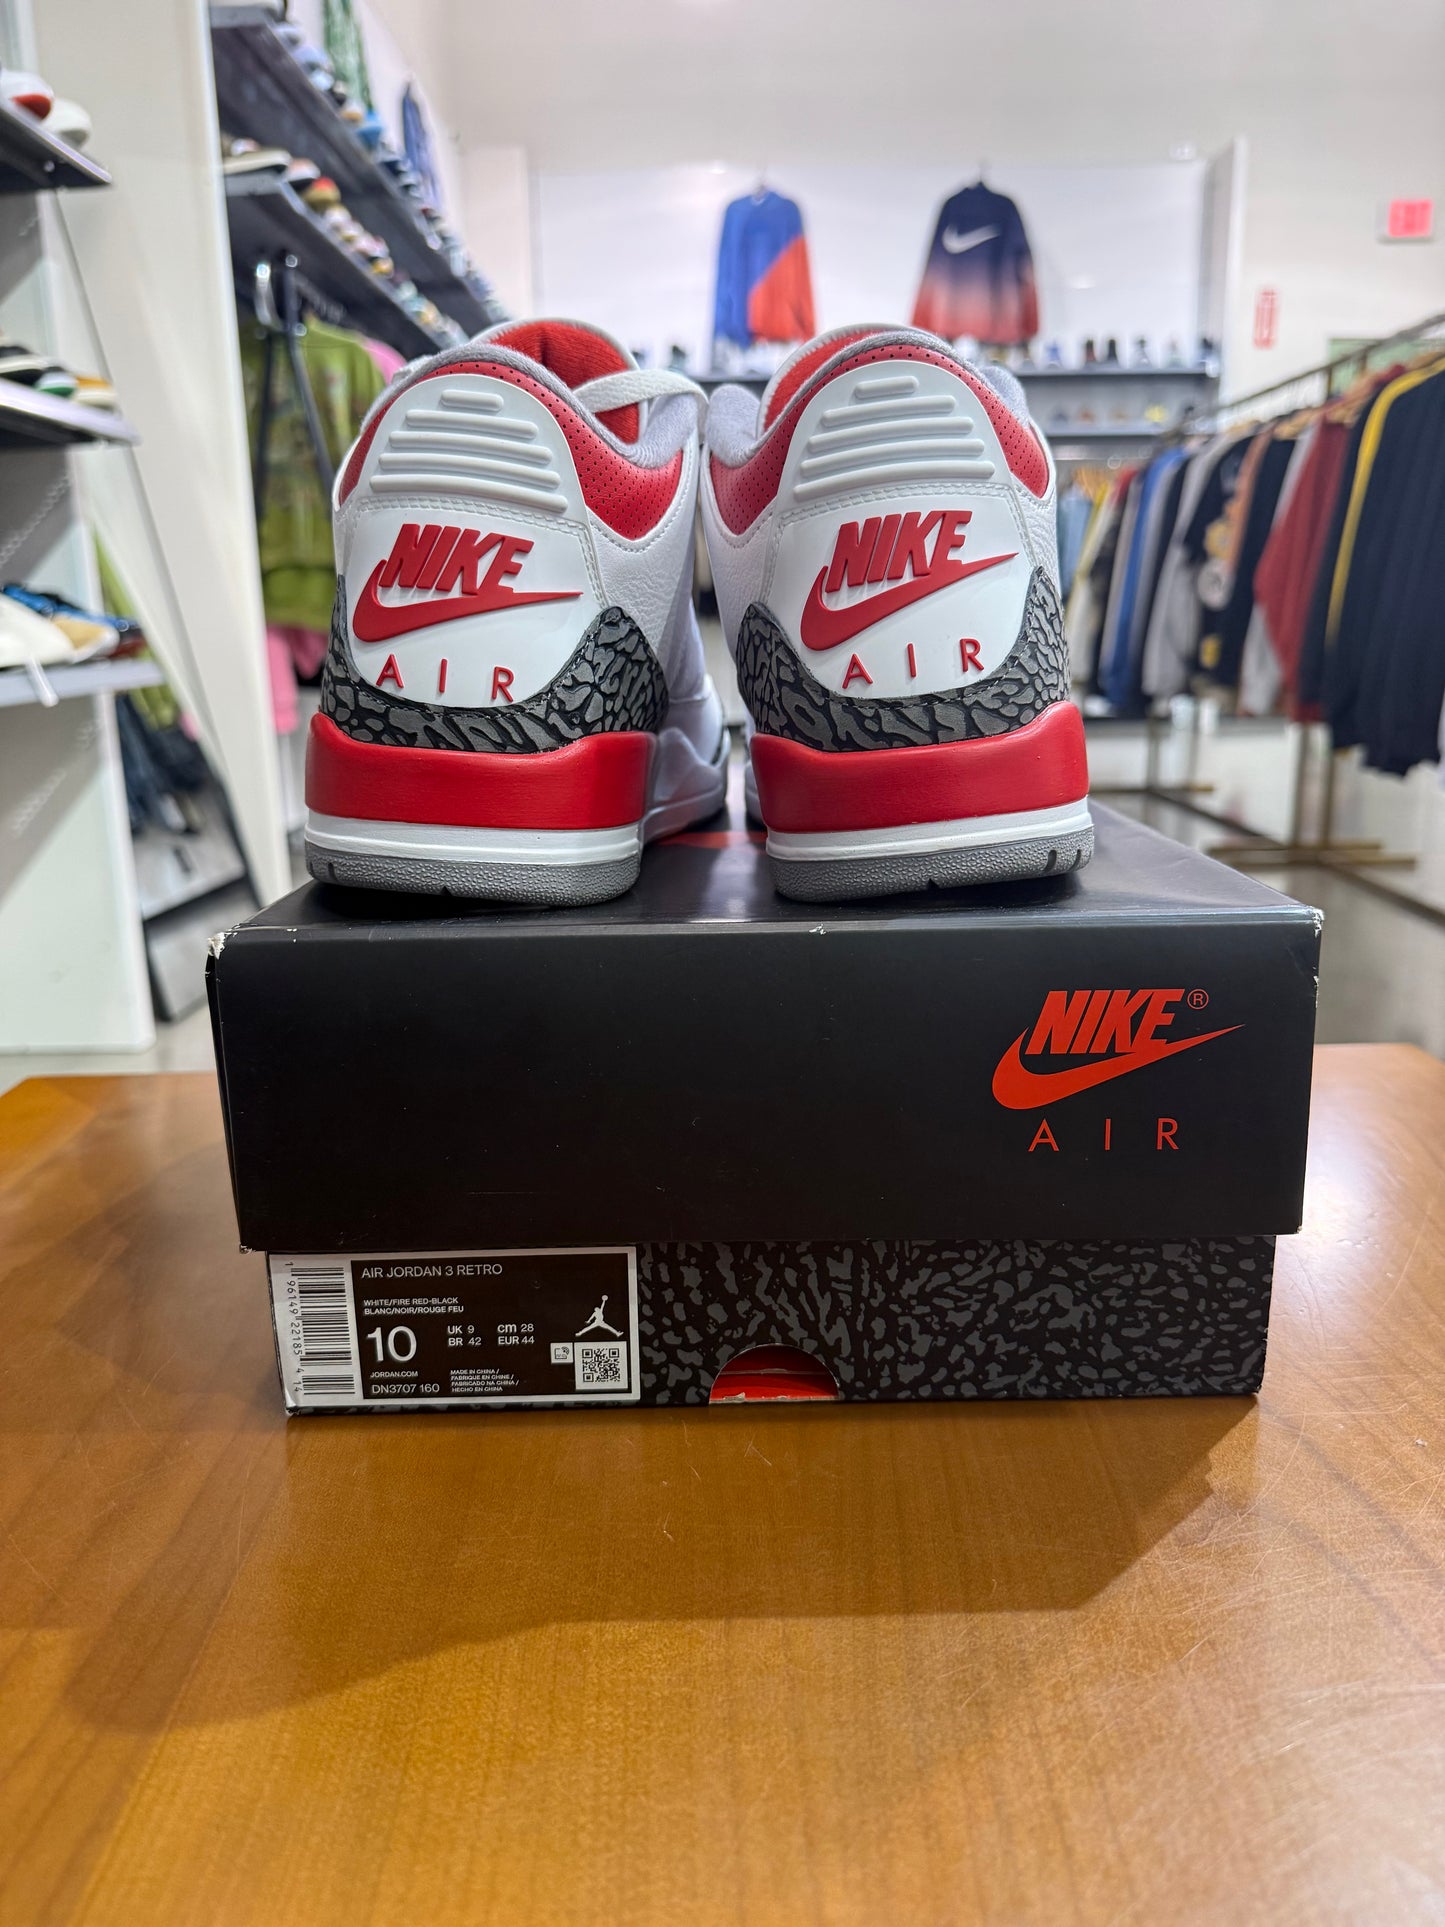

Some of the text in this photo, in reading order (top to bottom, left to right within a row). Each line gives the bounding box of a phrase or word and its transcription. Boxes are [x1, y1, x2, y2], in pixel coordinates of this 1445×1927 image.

[825, 511, 973, 593] NIKE
[378, 523, 535, 596] NIKE
[361, 1263, 503, 1279] AIR JORDAN 3 RETRO
[286, 1280, 299, 1315] 96149
[363, 1296, 459, 1307] WHITE/FIRE RED-BLACK
[364, 1305, 464, 1316] BLANC/NOIR/ROUGE FEU
[447, 1325, 475, 1335] UK 9
[497, 1323, 535, 1334] cm 28
[290, 1322, 303, 1356] 22185
[366, 1325, 418, 1363] 10
[447, 1336, 482, 1347] BR 42
[497, 1335, 535, 1346] EUR 44
[369, 1370, 419, 1379] JORDAN.COM
[371, 1383, 440, 1395] DN3707 160
